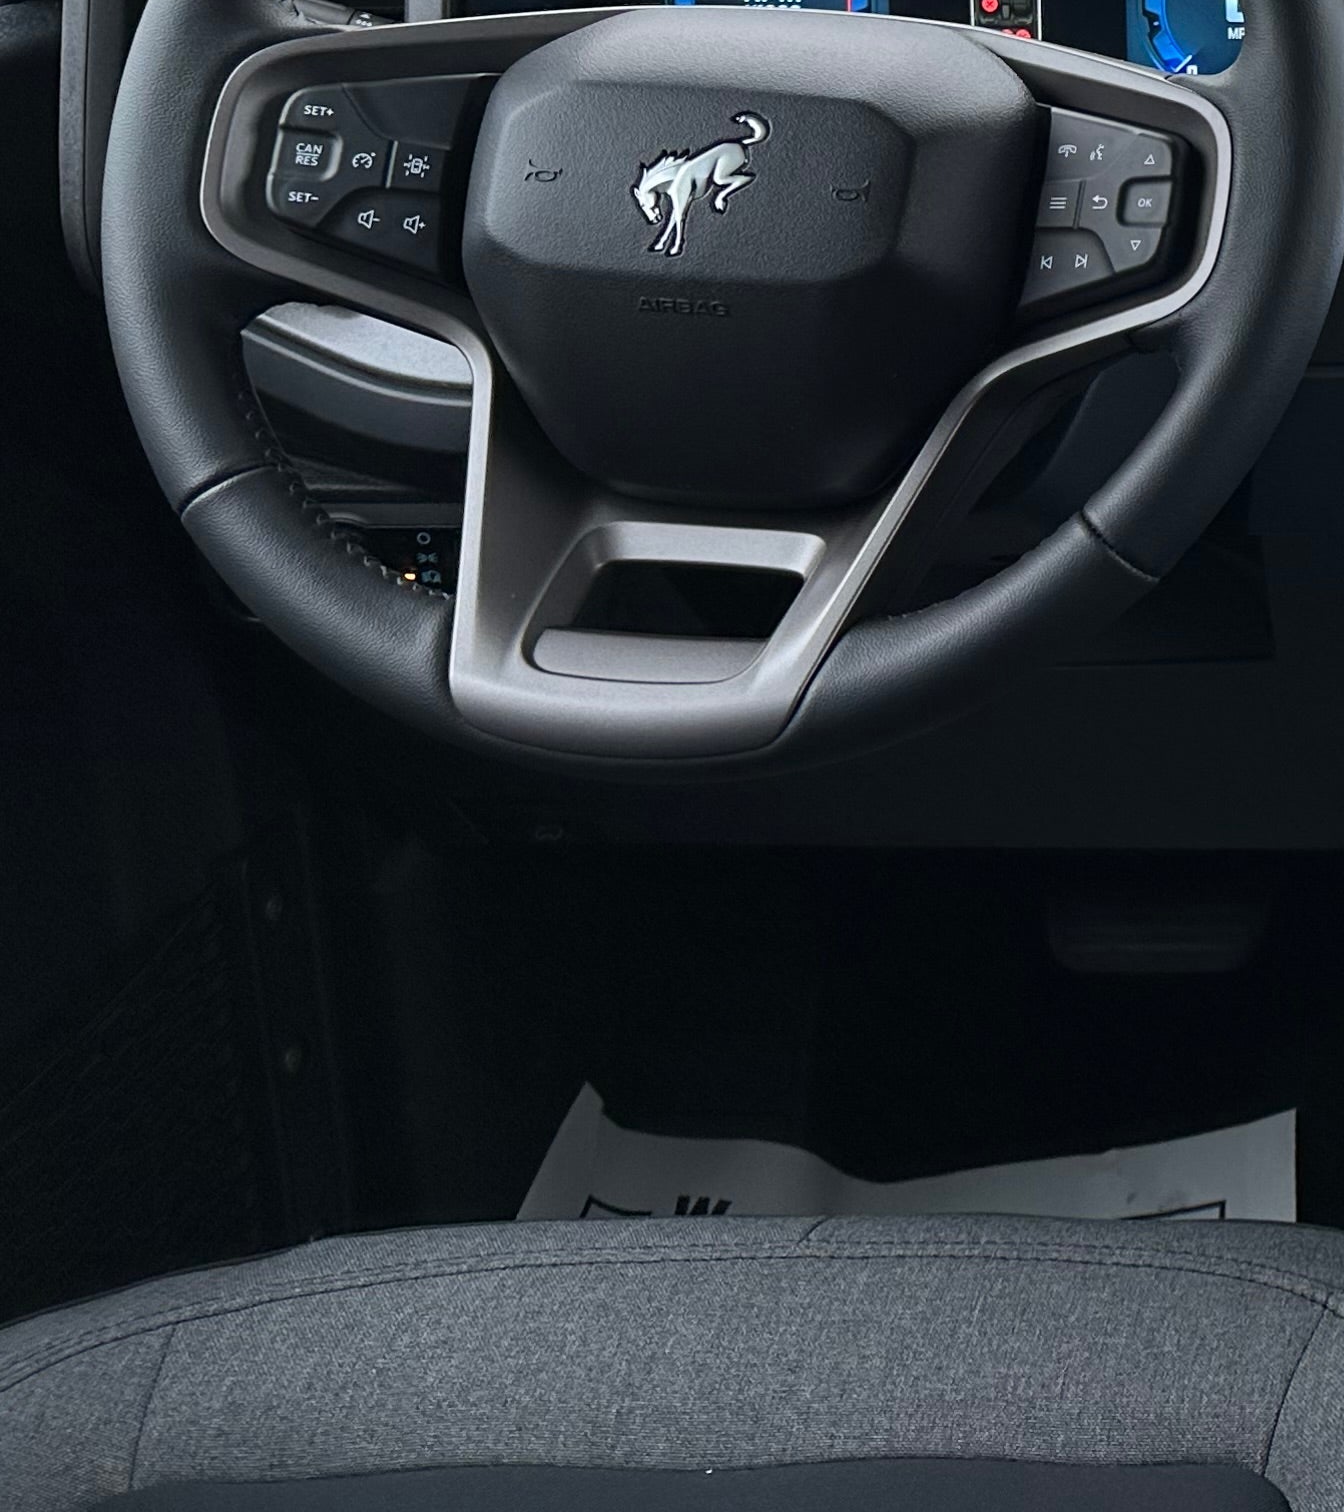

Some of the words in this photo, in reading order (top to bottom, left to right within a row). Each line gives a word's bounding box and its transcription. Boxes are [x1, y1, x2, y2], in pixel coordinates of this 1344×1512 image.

[1228, 27, 1246, 39] MP
[304, 105, 334, 116] SET+
[296, 143, 323, 154] CAN
[295, 156, 319, 166] RES
[1138, 198, 1152, 207] OK
